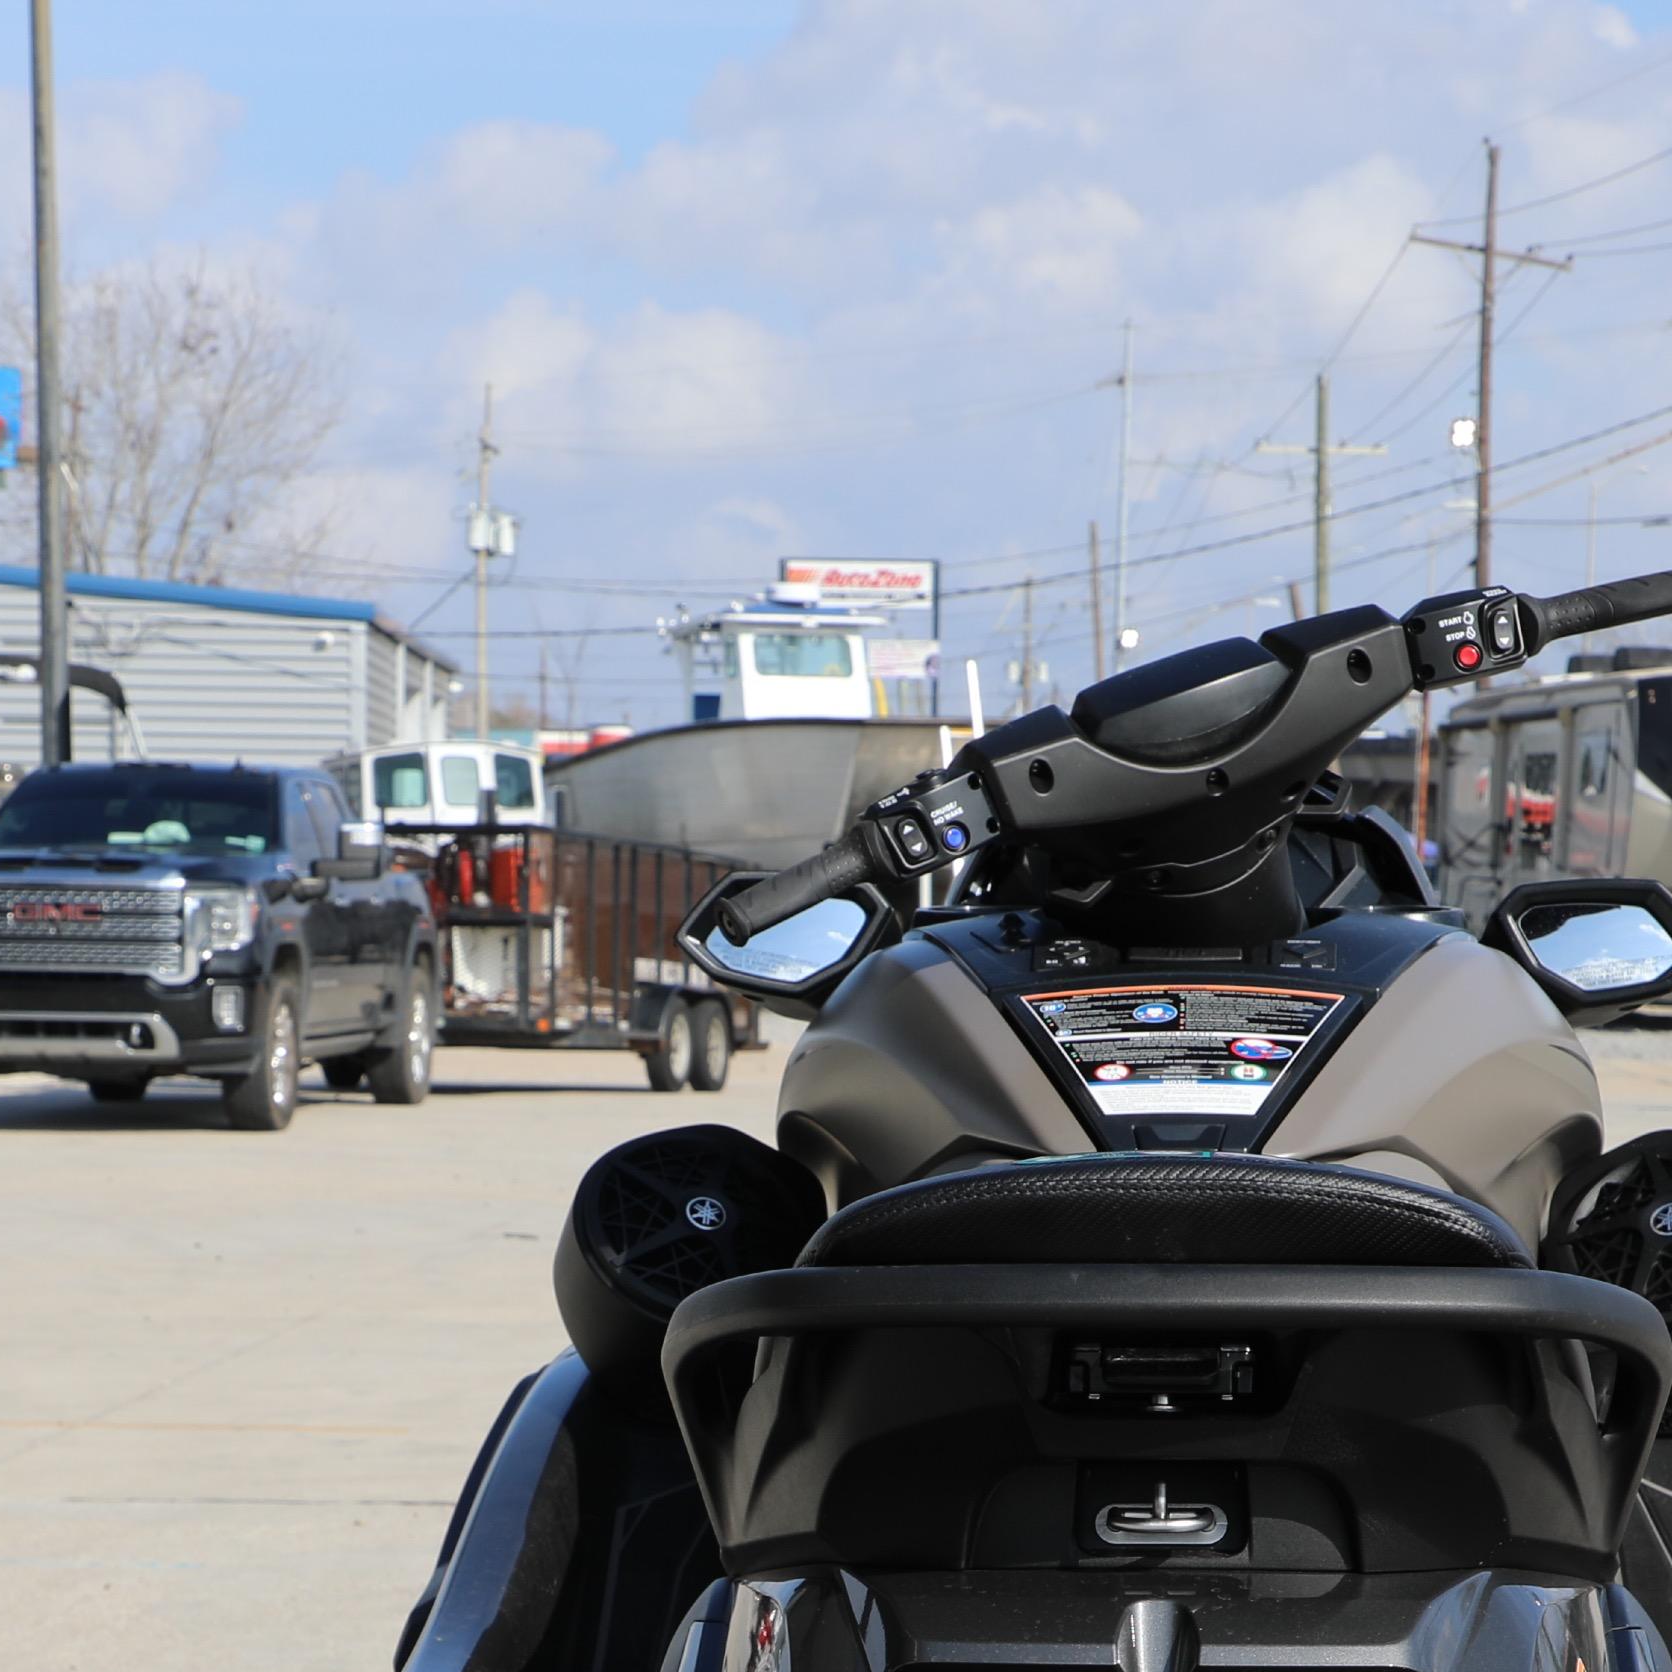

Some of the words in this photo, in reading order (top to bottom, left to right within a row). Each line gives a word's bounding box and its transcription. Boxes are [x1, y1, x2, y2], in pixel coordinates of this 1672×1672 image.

[1438, 616, 1462, 627] START
[1445, 631, 1465, 642] STOP
[13, 903, 104, 922] GMC
